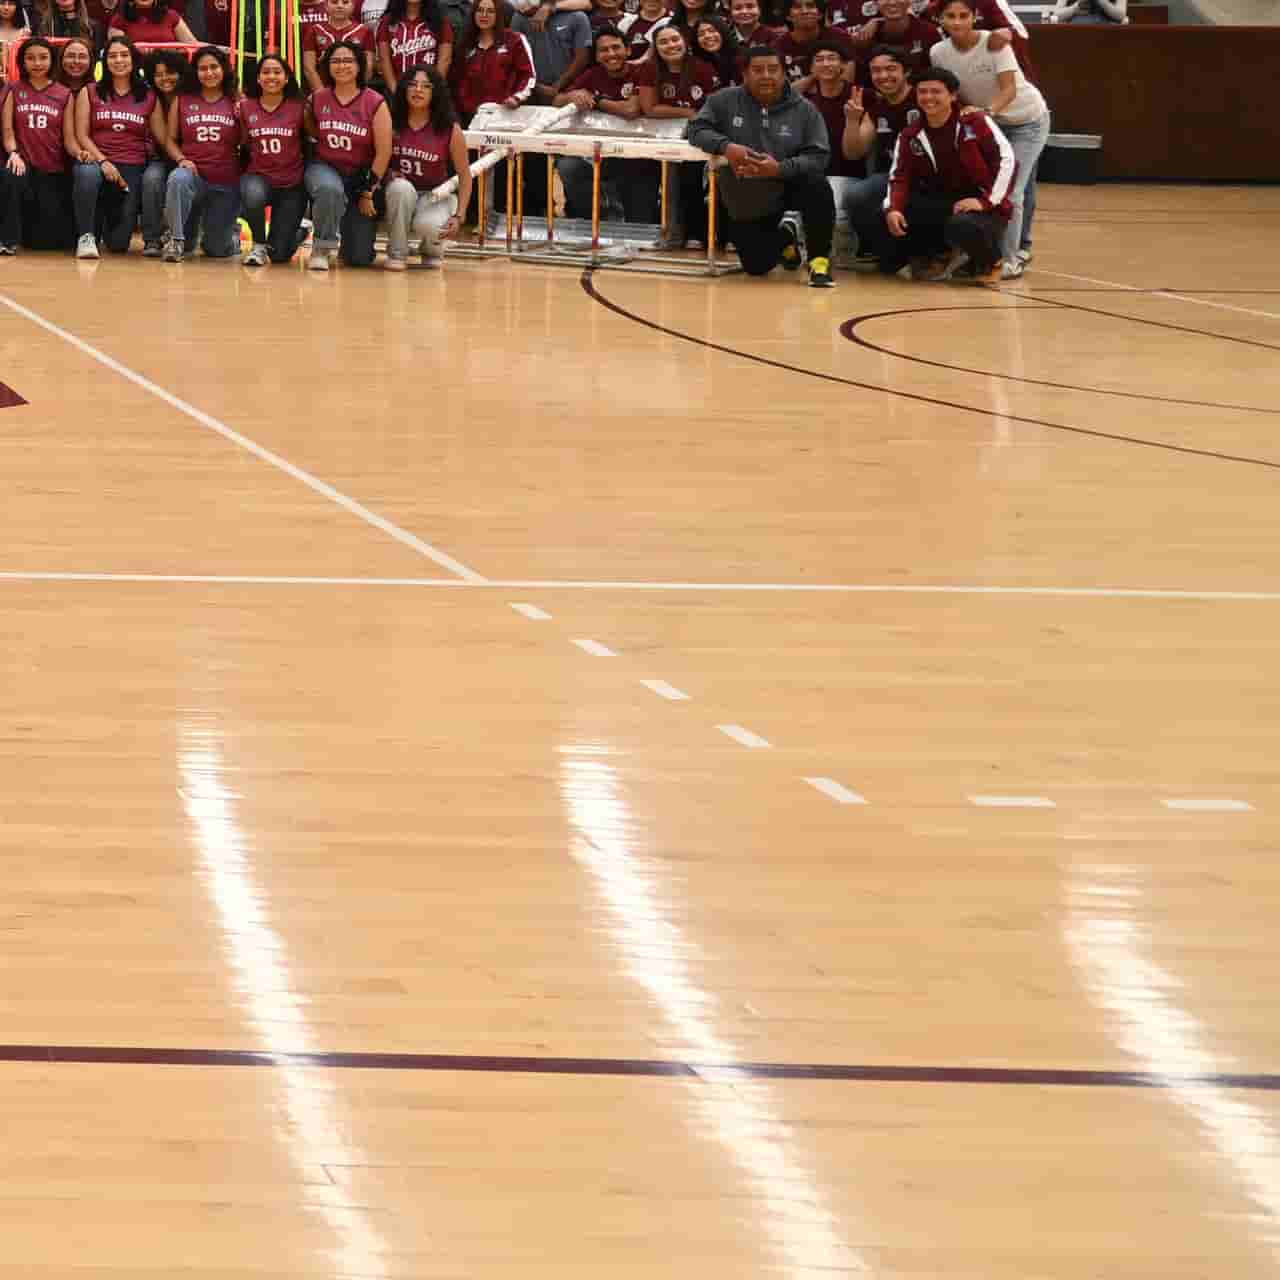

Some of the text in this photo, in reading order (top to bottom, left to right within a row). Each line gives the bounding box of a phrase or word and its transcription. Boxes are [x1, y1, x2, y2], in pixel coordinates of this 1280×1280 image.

[27, 113, 48, 129] 18
[196, 126, 221, 142] 25
[260, 138, 281, 154] 10
[400, 159, 423, 176] 91
